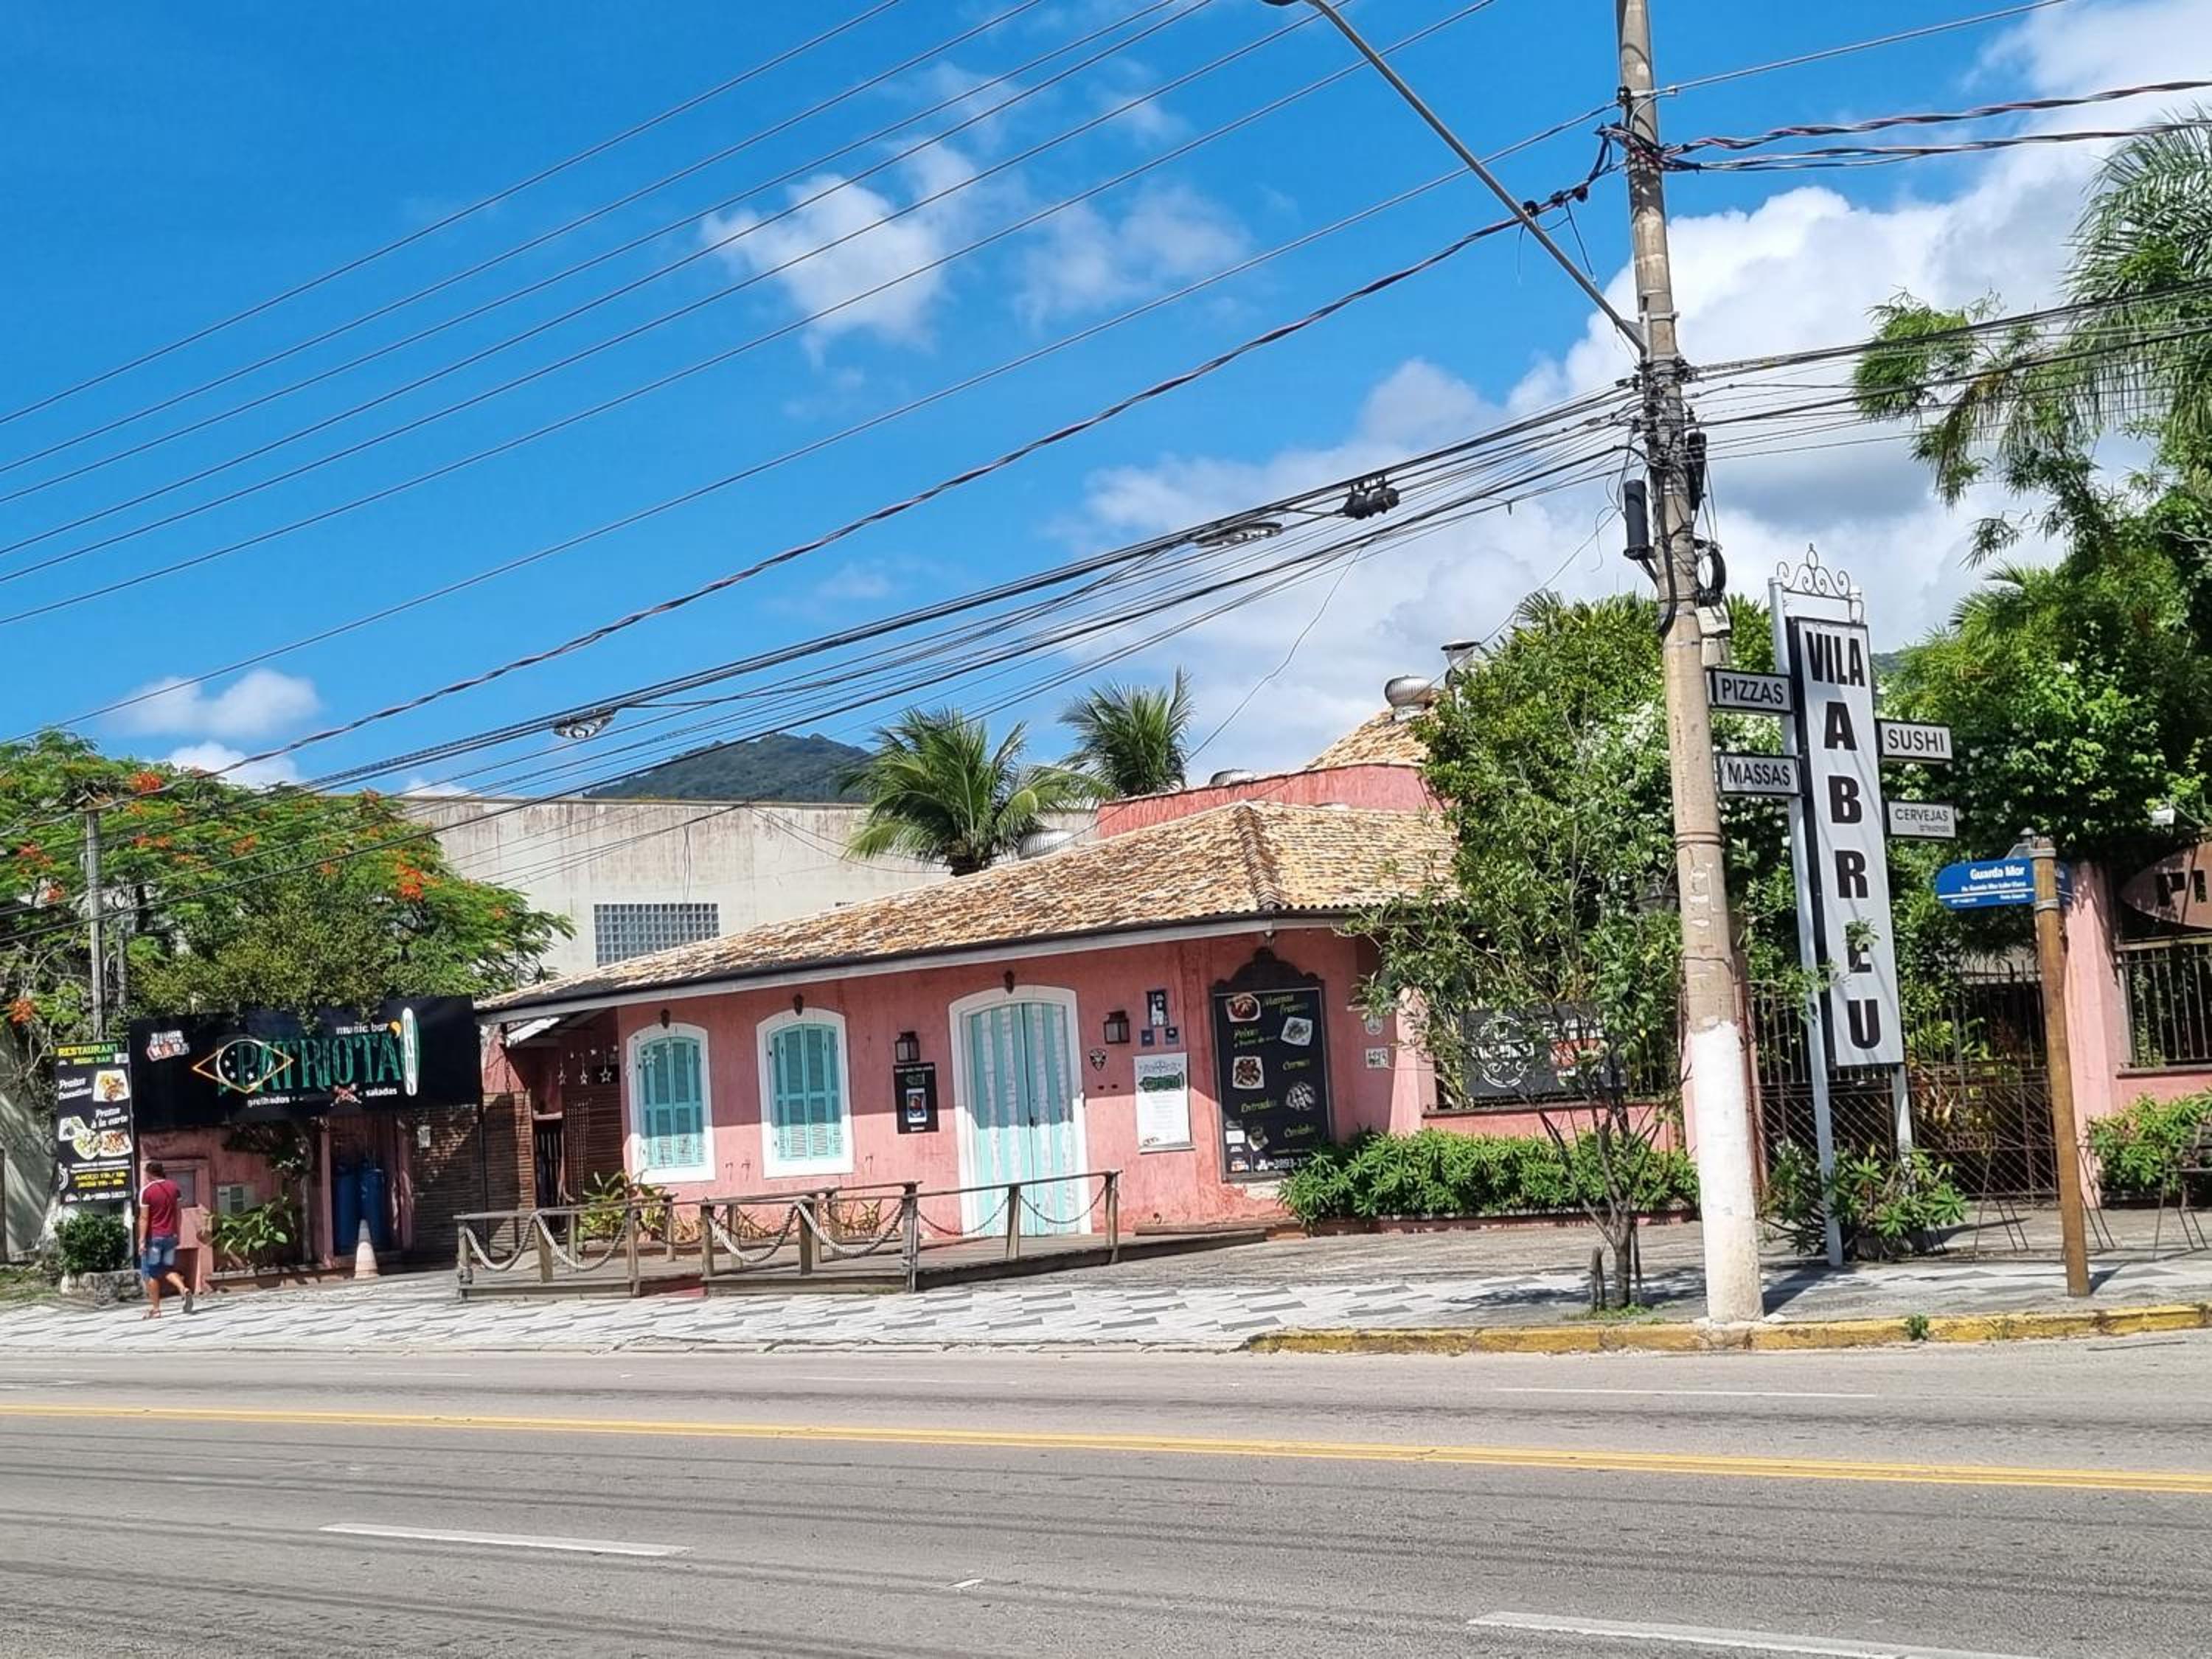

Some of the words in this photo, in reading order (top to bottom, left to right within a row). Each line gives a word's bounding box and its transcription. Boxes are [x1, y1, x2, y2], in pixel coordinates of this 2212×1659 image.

[1805, 630, 1866, 687] VILA
[1722, 678, 1784, 705] PIZZAS
[1888, 728, 1945, 752] SUSHI
[1728, 762, 1791, 787] MASSAS
[1894, 807, 1949, 822] CERVEJAS
[1823, 701, 1880, 1049] ABREU
[1969, 866, 2004, 880] Guarda
[2005, 865, 2026, 877] Mor
[371, 1022, 388, 1032] bar
[236, 1034, 402, 1093] PATRIOTA
[366, 1087, 397, 1097] saladas
